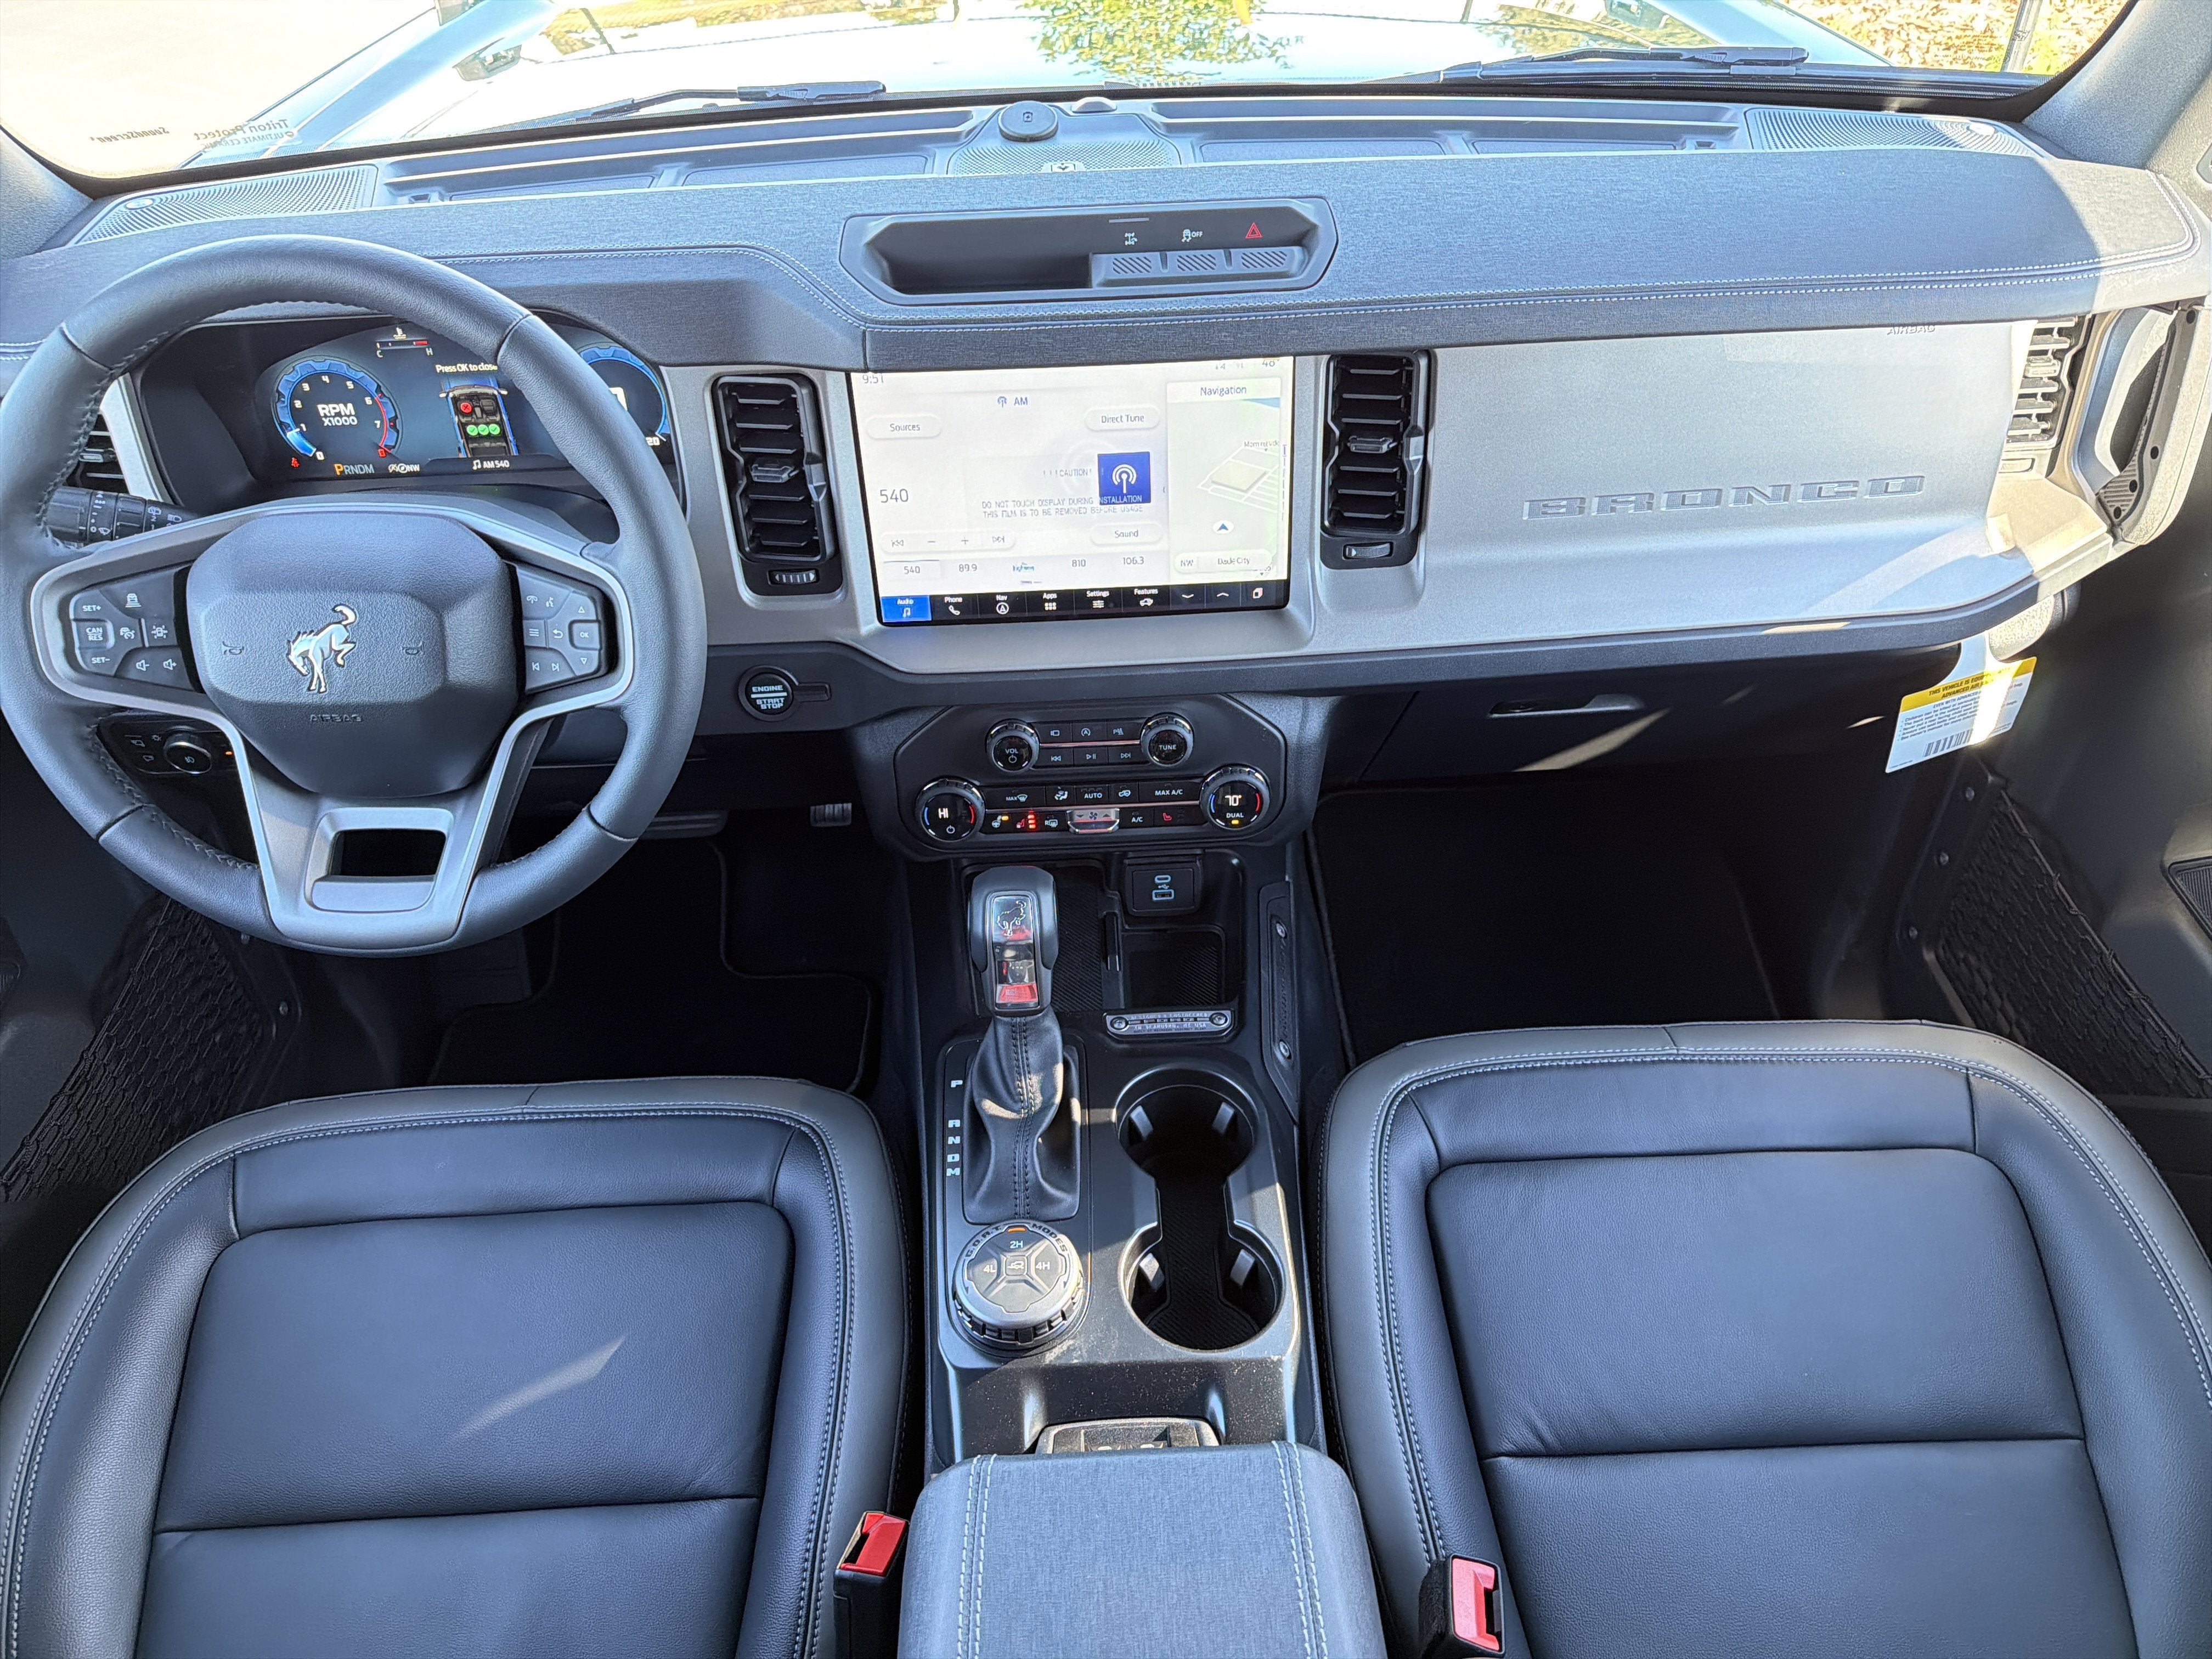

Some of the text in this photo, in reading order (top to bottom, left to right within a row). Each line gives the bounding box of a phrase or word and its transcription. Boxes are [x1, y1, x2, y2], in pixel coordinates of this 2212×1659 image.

[426, 347, 433, 356] H
[435, 364, 457, 373] Press
[478, 362, 498, 371] close
[321, 375, 330, 383] 4
[346, 381, 354, 389] 5
[1200, 386, 1247, 397] Navigation
[294, 400, 302, 408] 2
[364, 397, 373, 405] 6
[1013, 396, 1028, 406] AM
[317, 403, 356, 417] RPM
[1101, 414, 1144, 424] Direct Tune
[300, 424, 307, 432] 1
[889, 422, 921, 432] Sources
[316, 452, 324, 460] 0
[483, 460, 510, 469] AM 540
[334, 464, 375, 476] PRNDM
[1059, 468, 1088, 477] CAUTION
[879, 489, 909, 503] 540
[1522, 475, 1925, 520] BRONCO
[982, 495, 1143, 509] DO NOT TOUCH DISPLAY DURING NSTALLATION
[983, 510, 998, 518] THIS
[1020, 509, 1027, 517] IS
[1030, 509, 1039, 517] TO
[1056, 506, 1087, 515] REMOVED
[1091, 505, 1118, 514] BEFORE
[1121, 505, 1143, 513] USAGE
[1114, 529, 1139, 538] Sound
[1122, 556, 1144, 566] 106.3
[904, 566, 921, 574] 540
[958, 563, 978, 572] 89.9
[1043, 592, 1057, 600] Apps
[1086, 590, 1109, 598] Settings
[1929, 688, 1941, 696] THIS
[1942, 681, 1964, 693] VEHICLE
[1941, 686, 1970, 698] ADVANCED
[1970, 682, 1979, 691] AIR
[938, 808, 949, 819] HI
[948, 1119, 960, 1128] R
[947, 1136, 960, 1144] N
[947, 1154, 960, 1162] D
[946, 1168, 960, 1176] M
[1031, 1223, 1069, 1252] MODES
[1009, 1240, 1024, 1249] 2H
[983, 1264, 997, 1273] 4L
[1035, 1261, 1051, 1270] 4H
